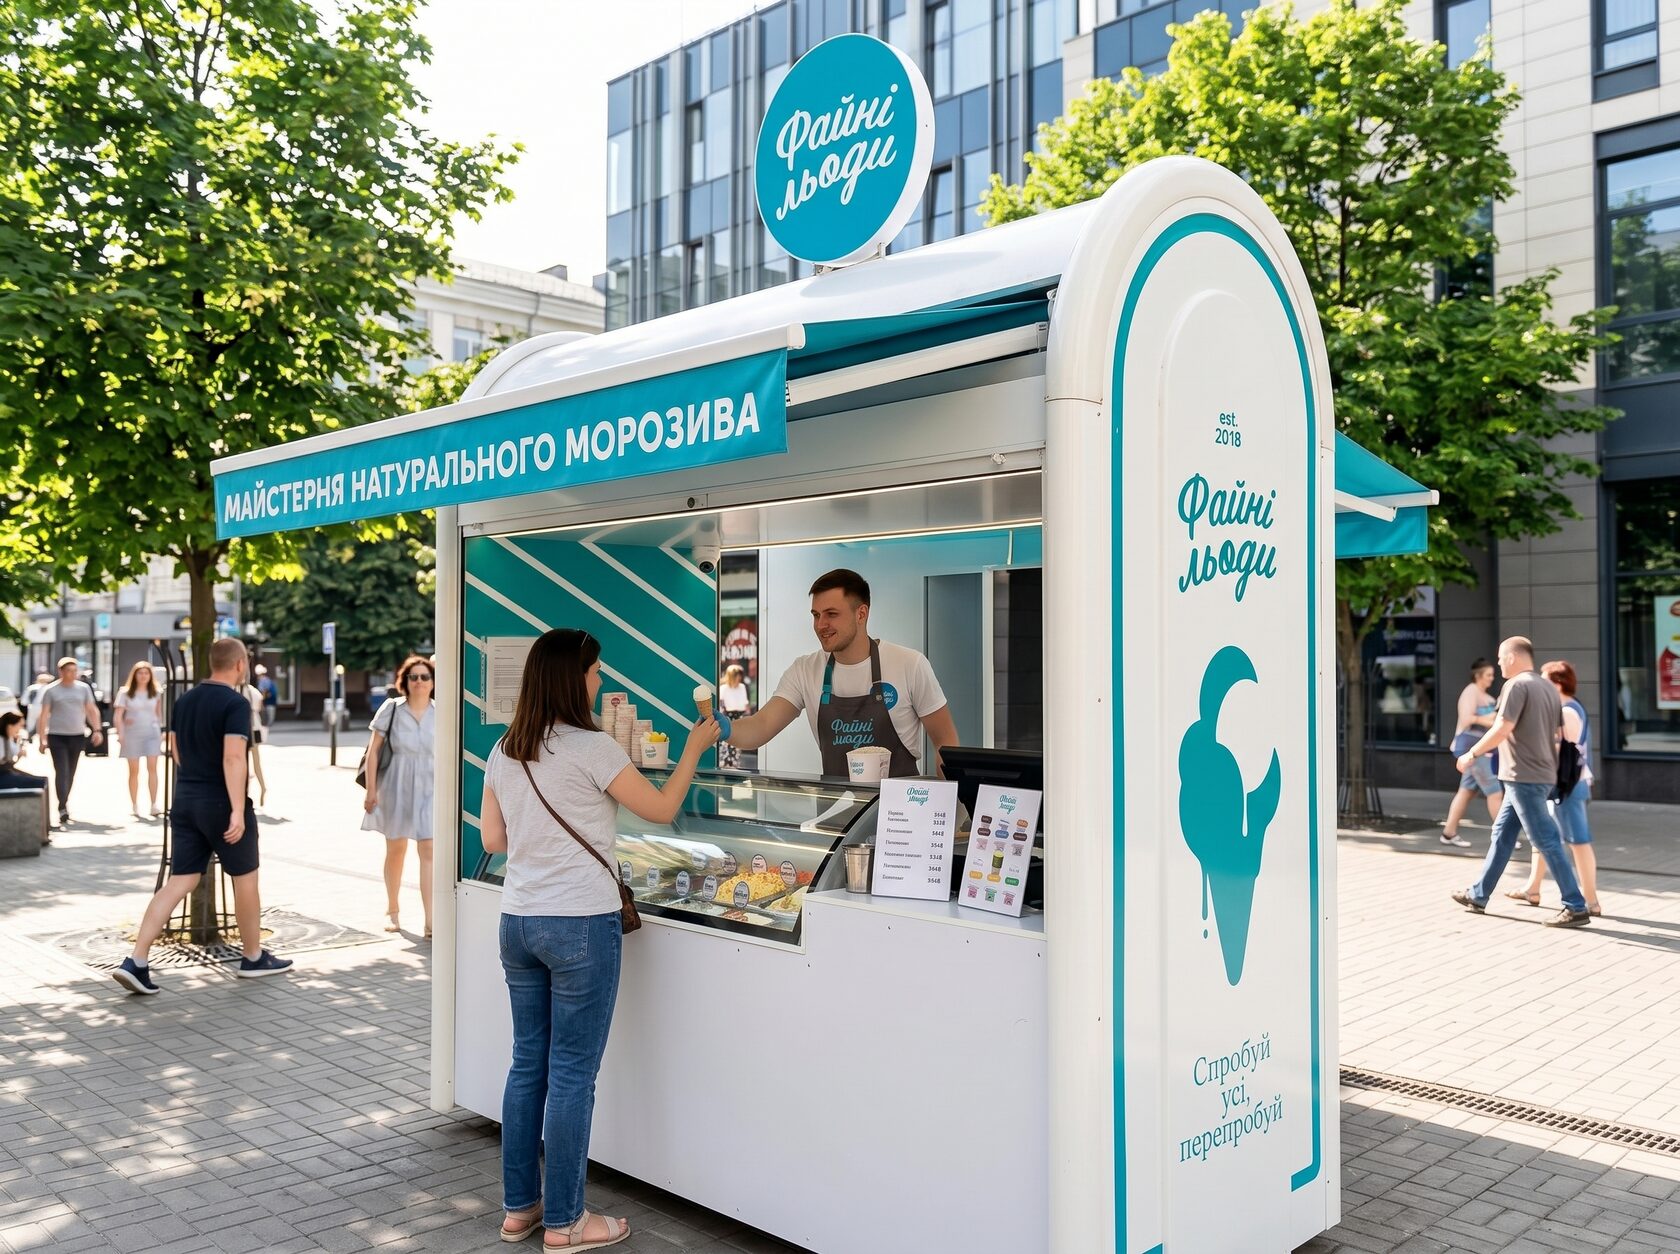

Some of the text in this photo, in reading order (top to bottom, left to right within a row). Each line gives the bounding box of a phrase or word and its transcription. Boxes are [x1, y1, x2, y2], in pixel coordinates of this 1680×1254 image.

[776, 83, 899, 171] Файні
[775, 135, 897, 221] льоди
[1215, 428, 1242, 448] 2018
[1219, 412, 1238, 427] est.
[224, 392, 760, 523] МАЙСТЕРНЯ НАТУРАЛЬНОГО МОРОЗИВА
[1178, 473, 1277, 541] Файні
[1178, 539, 1277, 602] льоди
[831, 718, 873, 734] Файні
[1193, 1032, 1271, 1086] Спробуй
[1180, 1094, 1283, 1162] перепробуй
[1221, 1075, 1250, 1119] усі,
